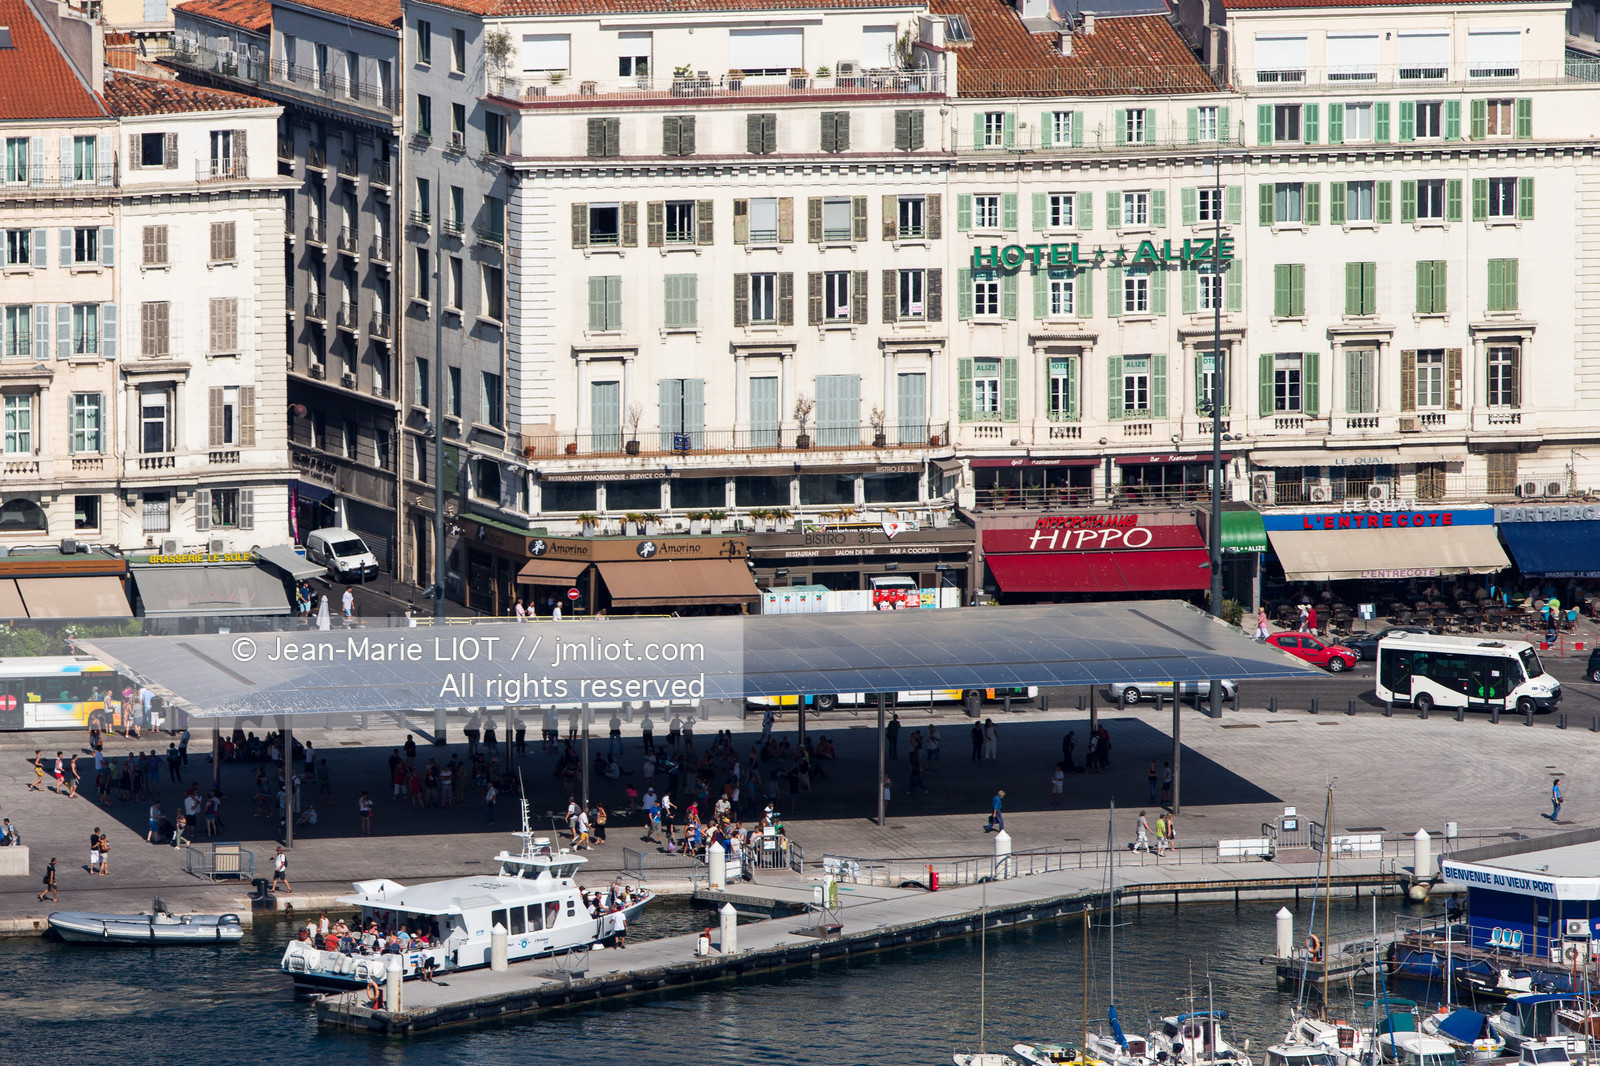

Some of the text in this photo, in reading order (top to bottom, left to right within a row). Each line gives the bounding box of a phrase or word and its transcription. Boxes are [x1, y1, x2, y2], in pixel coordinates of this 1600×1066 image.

[973, 241, 1089, 268] HOTEL
[1353, 456, 1384, 464] QUAI
[876, 465, 897, 473] BISTRO
[1343, 500, 1360, 512] LE
[1035, 514, 1139, 529] HIPPOPOTAMUS
[1303, 512, 1453, 529] L'ENTRECOTE
[805, 533, 846, 545] BISTRO
[858, 532, 871, 544] 31
[1030, 527, 1152, 550] HIPPO
[548, 542, 588, 554] Amorino
[658, 541, 701, 553] Amorino
[149, 554, 203, 564] BRASSERIE
[207, 553, 220, 562] LE
[1360, 568, 1436, 578] L'ENTRECOTE
[1444, 866, 1554, 894] BIENVENUE AU VIEUX PORT
